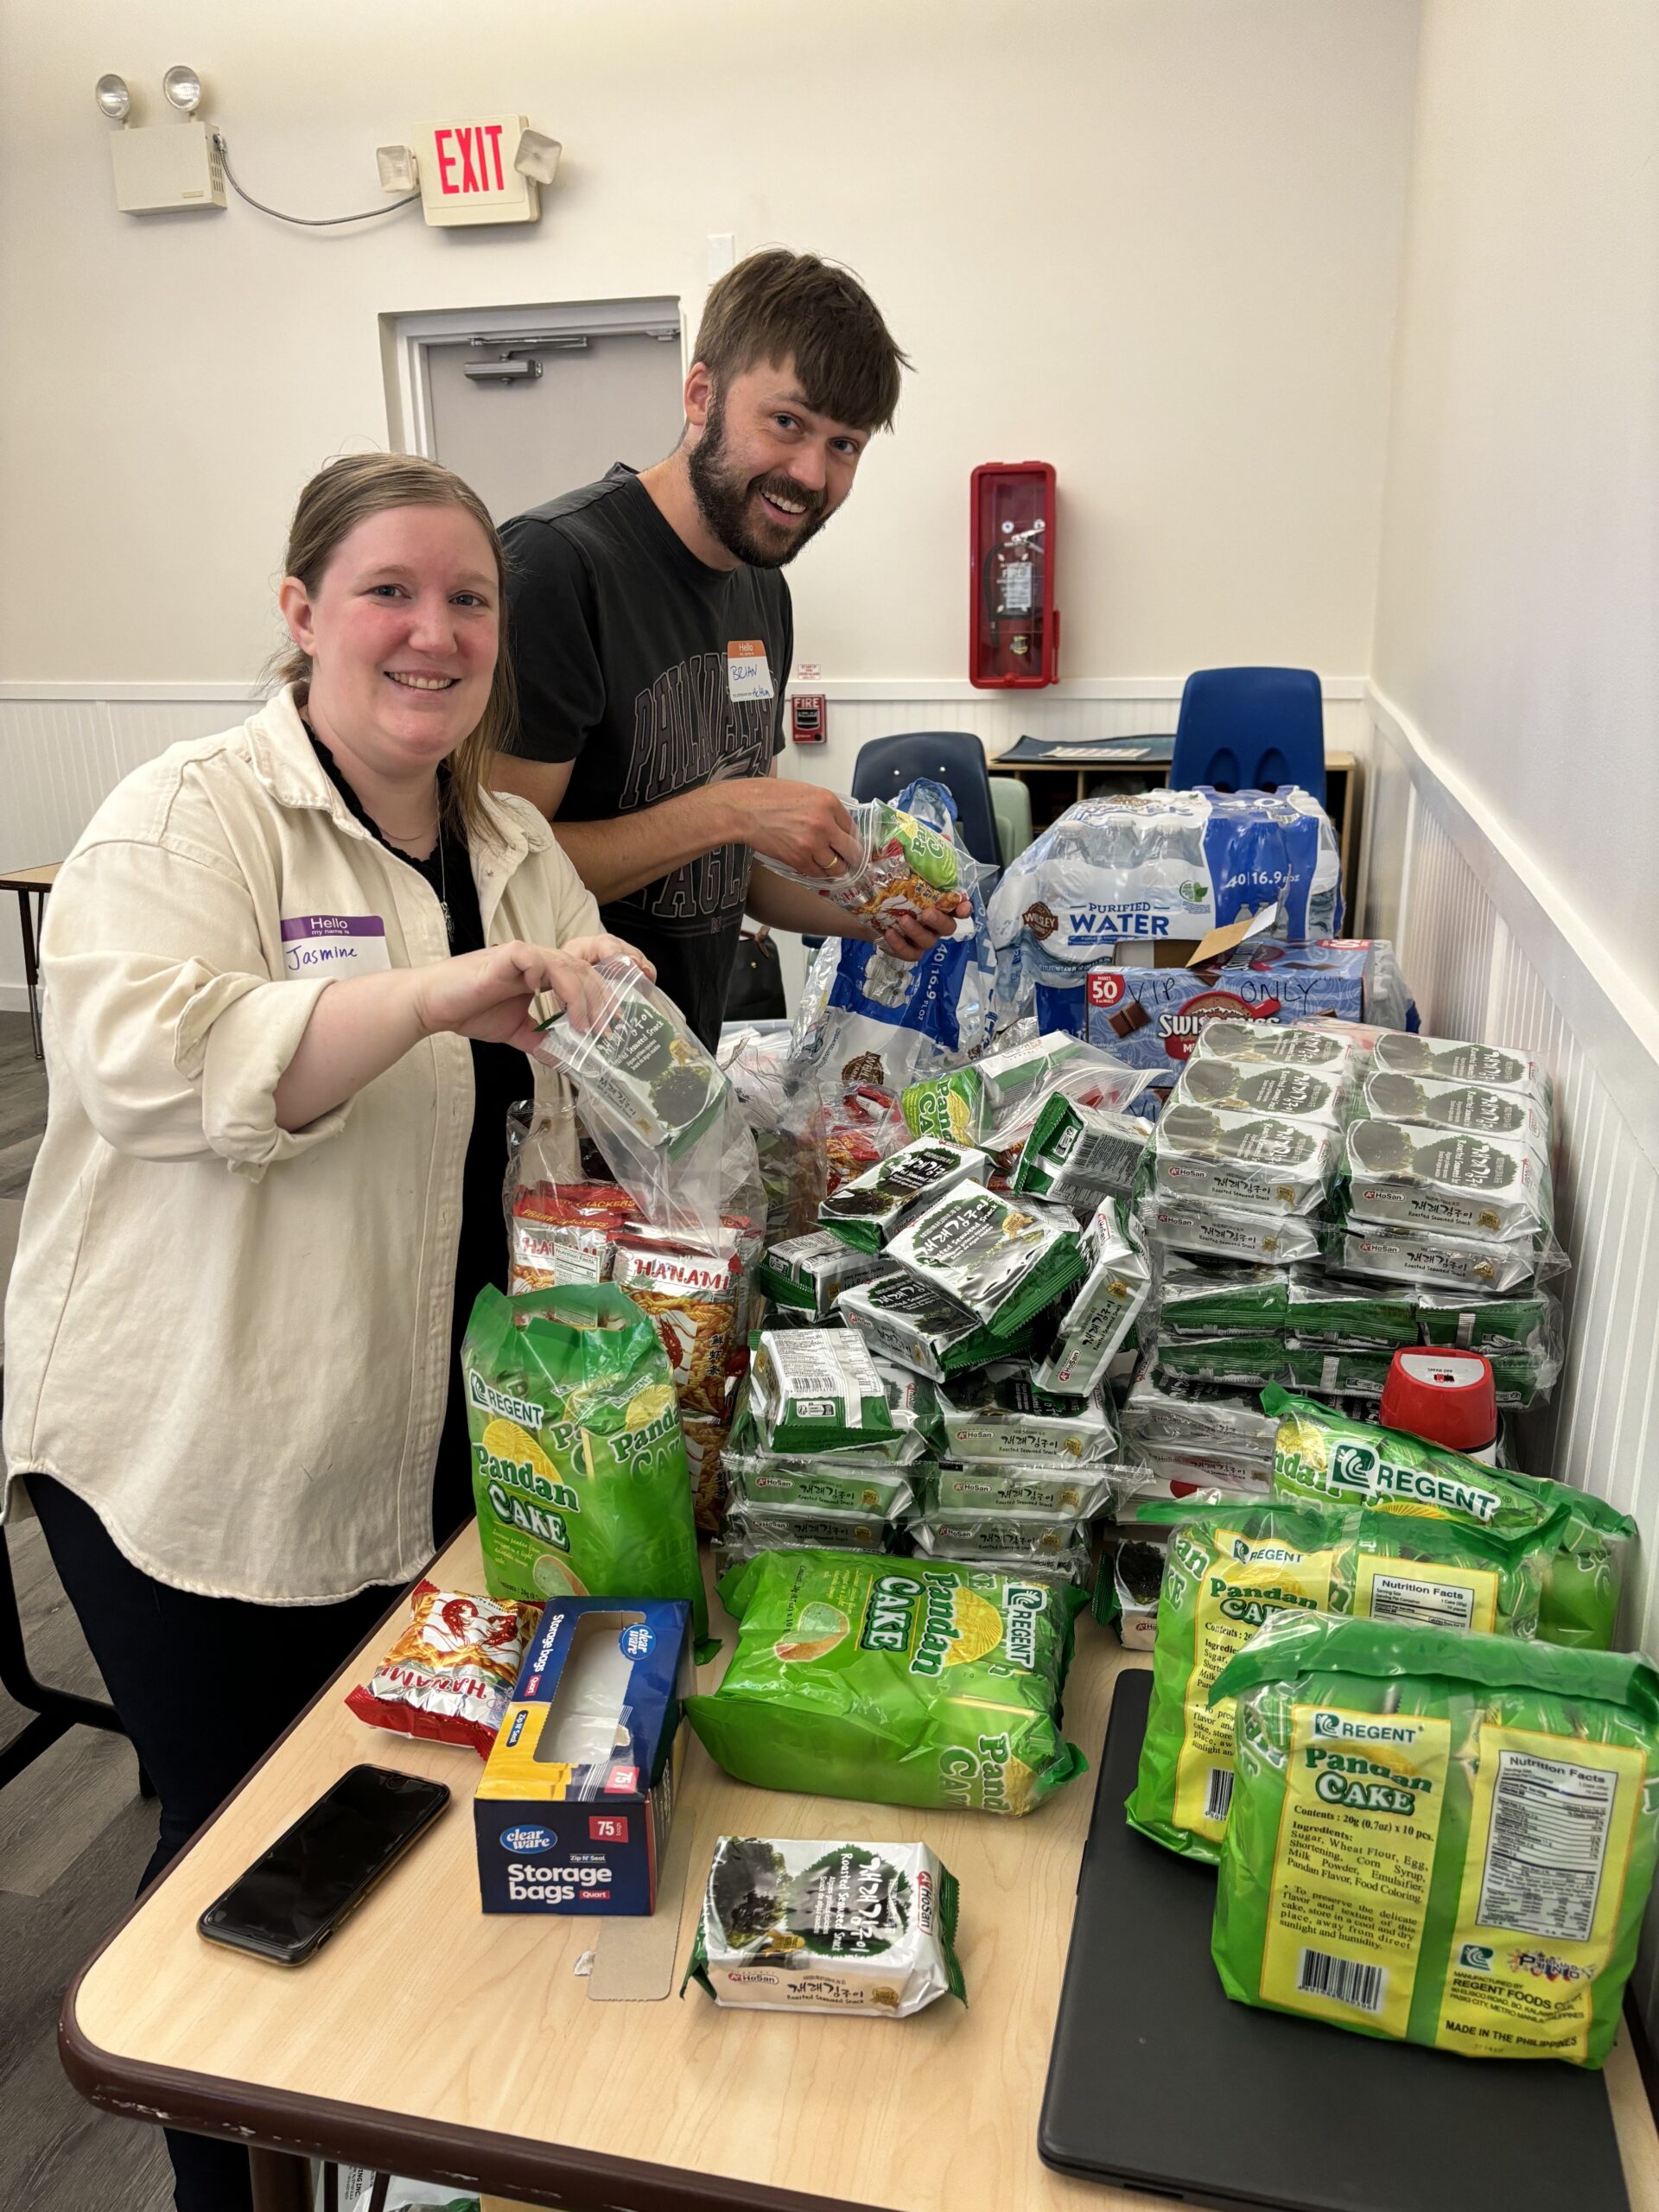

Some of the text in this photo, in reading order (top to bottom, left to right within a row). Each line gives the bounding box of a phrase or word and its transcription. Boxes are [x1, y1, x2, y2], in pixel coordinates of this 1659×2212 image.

[435, 124, 505, 194] EXIT
[730, 664, 758, 681] BRIAN
[794, 697, 820, 708] FIRE
[1224, 871, 1282, 888] 40 16.9
[1088, 901, 1151, 913] PURIFIED
[310, 918, 348, 930] Hello
[1070, 913, 1170, 936] WATER
[286, 945, 359, 971] Jasmine
[932, 943, 949, 962] 40
[928, 968, 940, 1001] 16.9
[1092, 981, 1118, 999] 50
[1128, 977, 1319, 1016] VIP ONLY
[1180, 1168, 1205, 1178] HoSan
[1375, 1191, 1402, 1201] HoSan
[521, 1209, 556, 1224] PRAWN
[951, 1204, 999, 1246] Seaweed Snack
[1167, 1216, 1193, 1226] HoSan
[1408, 1211, 1471, 1226] Roasted Seaweed Snack
[1370, 1243, 1398, 1254] HoSan
[634, 1258, 730, 1291] HANAMI
[1064, 1351, 1080, 1375] HoSan
[487, 1388, 544, 1427] REGENT
[966, 1430, 993, 1440] HoSan
[473, 1441, 582, 1514] Pandan
[766, 1478, 791, 1487] HoSan
[963, 1483, 989, 1493] HoSan
[1376, 1467, 1497, 1519] REGENT
[487, 1479, 571, 1554] CAKE
[1250, 1549, 1305, 1563] REGENT
[1210, 1576, 1319, 1611] Pandan
[1382, 1579, 1465, 1600] Nutrition Facts
[861, 1574, 926, 1652] CAKE
[911, 1571, 963, 1678] Pandan
[639, 1628, 650, 1654] clear
[1011, 1610, 1033, 1667] REGENT
[1205, 1621, 1238, 1638] Contents
[532, 1613, 566, 1673] Storage bags
[626, 1629, 639, 1656] ware
[1204, 1649, 1229, 1664] Sugar,
[380, 1667, 487, 1700] HANAMI
[526, 1675, 540, 1695] Quart
[1199, 1669, 1217, 1681] Milk
[1193, 1712, 1216, 1726] flavor
[509, 1731, 521, 1745] Seal
[1193, 1723, 1233, 1740] cake, store
[1341, 1722, 1417, 1744] REGENT
[1192, 1740, 1221, 1755] sunlight
[615, 1771, 633, 1784] 75
[1305, 1747, 1434, 1795] Pandan
[1509, 1756, 1606, 1784] Nutrition Facts
[1315, 1770, 1415, 1816] CAKE
[506, 1828, 544, 1842] clear
[597, 1821, 614, 1837] 75
[1292, 1821, 1354, 1841] Ingredients:
[1294, 1804, 1335, 1821] Contents
[1343, 1814, 1360, 1827] 20g
[1361, 1816, 1393, 1833] (0.7oz)
[1402, 1824, 1414, 1835] 10
[1415, 1830, 1434, 1843] pcs.
[512, 1836, 550, 1850] ware
[1290, 1830, 1429, 1873] Sugar, Wheat Flour, Egg,
[1288, 1848, 1425, 1893] Milk Powder, Emulsifier,
[1289, 1840, 1427, 1884] Shortening, Corn Syrup,
[507, 1863, 613, 1887] Storage
[1287, 1857, 1320, 1876] Pandan
[1321, 1867, 1353, 1887] Flavor,
[1354, 1878, 1379, 1892] Food
[509, 1881, 575, 1904] bags
[830, 1853, 854, 1952] Roasted Seaweed Snack
[849, 1856, 884, 1954] 재래김구이
[918, 1888, 933, 1929] HoSan
[1282, 1891, 1416, 1934] flavor and texture of this
[1294, 1885, 1418, 1926] To preserve the delicate
[1281, 1901, 1306, 1914] cake,
[1308, 1907, 1332, 1919] store
[1333, 1913, 1344, 1922] in
[1353, 1916, 1376, 1930] cool
[1377, 1923, 1396, 1936] and
[1396, 1929, 1415, 1942] dry
[1281, 1910, 1411, 1950] place, away from direct
[1279, 1918, 1383, 1950] sunlight and humidity.
[740, 1974, 776, 1985] HoSan
[787, 1982, 865, 1999] 재래김구이
[1453, 1971, 1510, 1988] MANUFACTURED
[786, 1993, 815, 2001] Roasted
[815, 1994, 844, 2004] Seaweed
[1452, 1978, 1552, 2009] REGENT FOODS
[1490, 2003, 1516, 2017] METRO
[1445, 2019, 1476, 2037] MADE
[1478, 2026, 1491, 2037] IN
[1493, 2031, 1513, 2044] THE
[1516, 2035, 1578, 2050] PHILIPPINES
